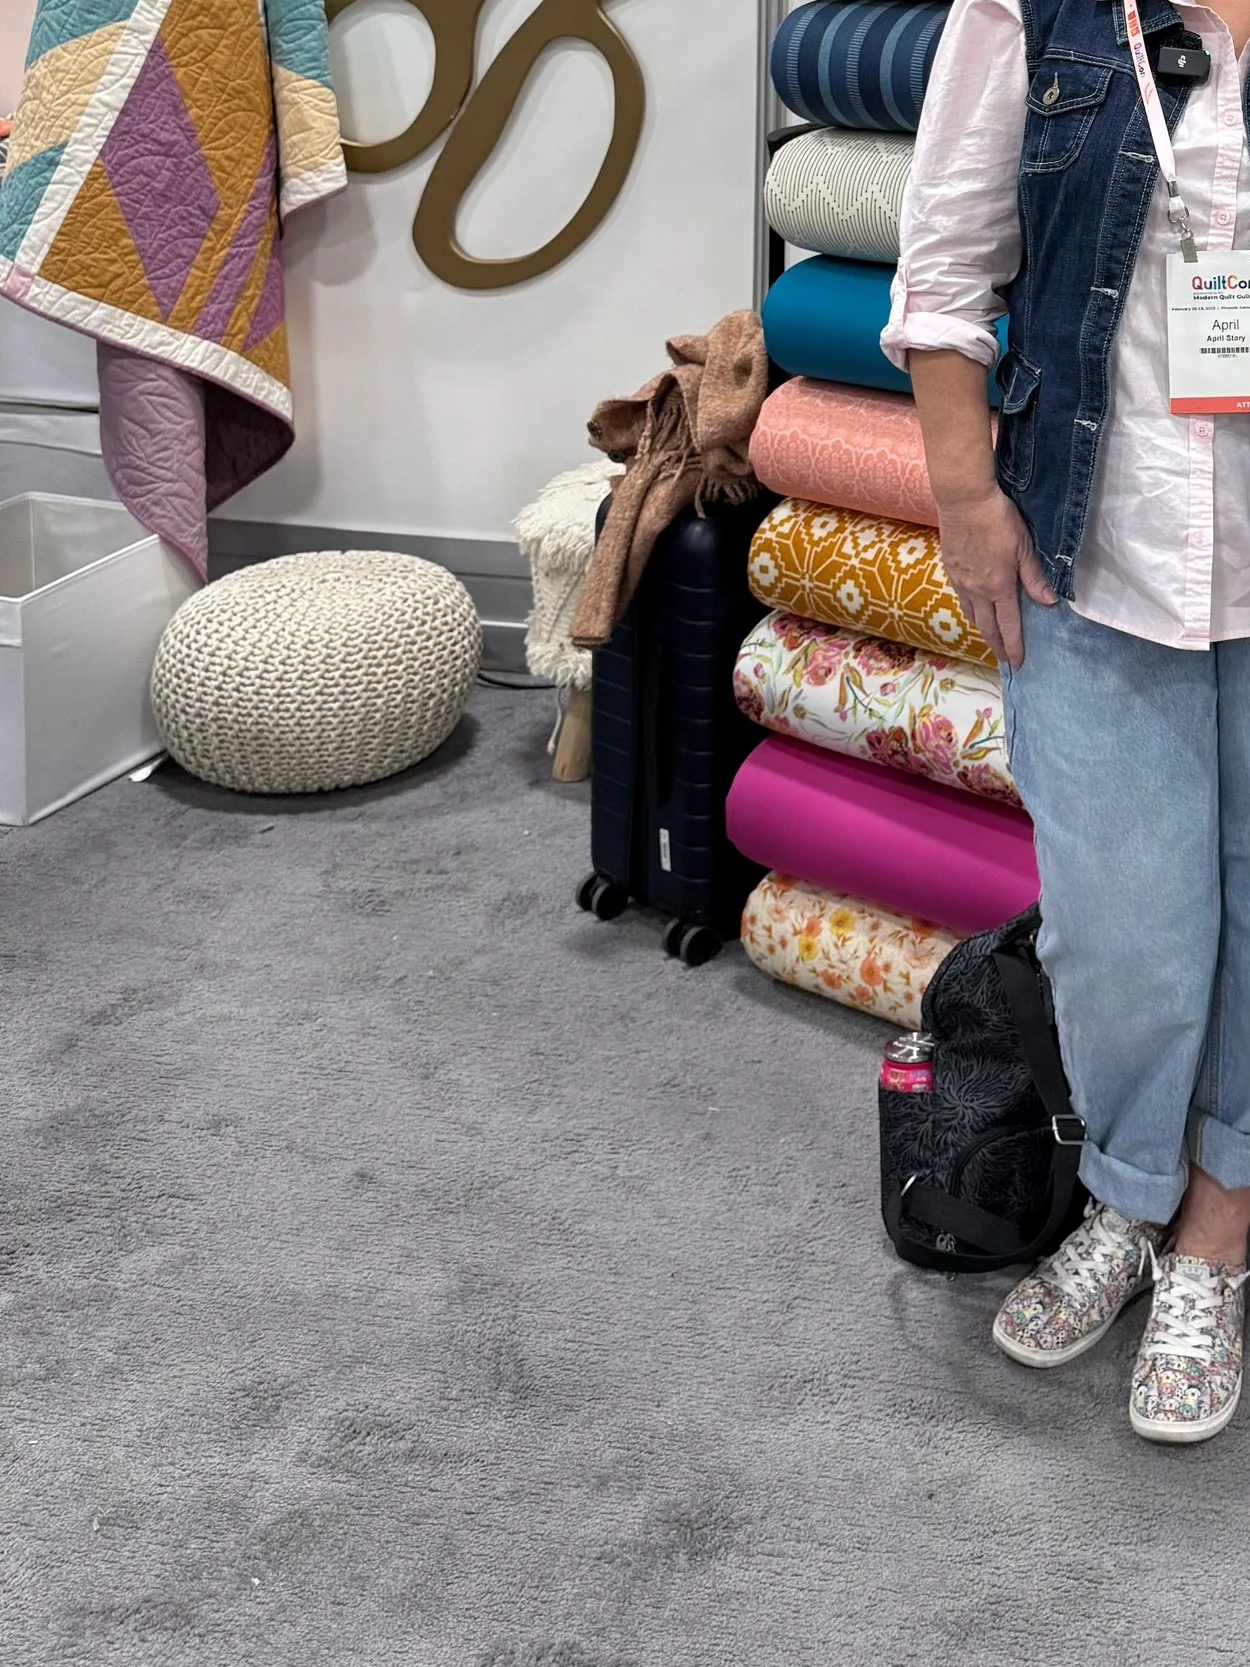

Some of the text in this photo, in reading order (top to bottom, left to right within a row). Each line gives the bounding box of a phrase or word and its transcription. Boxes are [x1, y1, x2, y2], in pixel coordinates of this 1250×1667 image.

[1212, 319, 1239, 332] April
[1206, 334, 1246, 343] April Story
